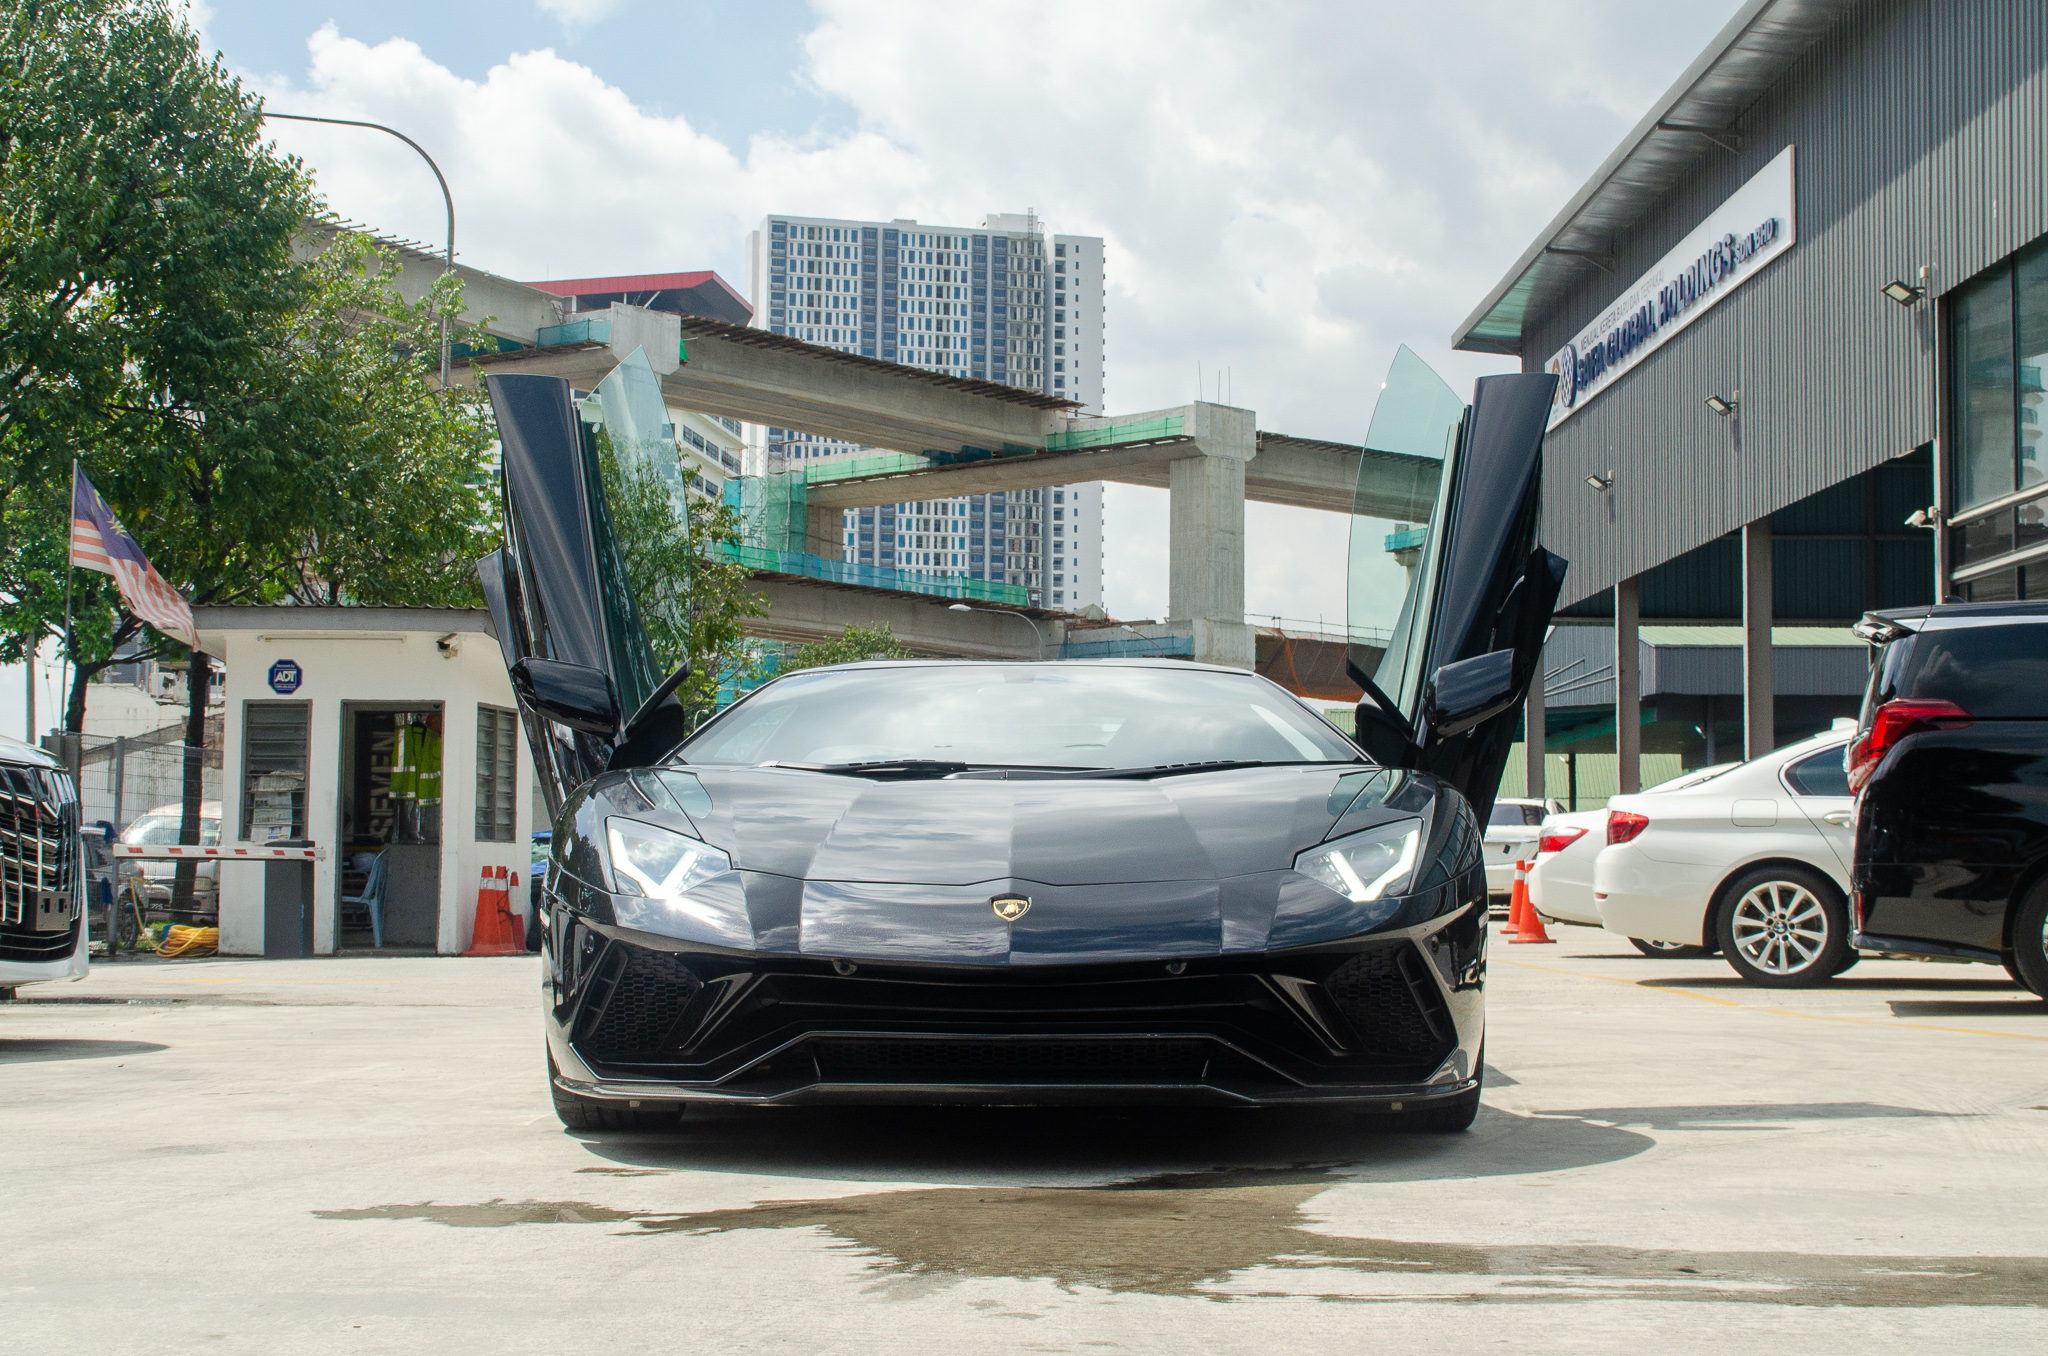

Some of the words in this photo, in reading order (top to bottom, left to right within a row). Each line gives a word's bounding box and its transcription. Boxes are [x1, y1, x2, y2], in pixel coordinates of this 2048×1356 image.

[1605, 300, 1656, 367] GLOBAL
[1658, 233, 1733, 327] HOLDINGS
[1734, 233, 1755, 264] SDN
[1755, 218, 1776, 250] BHD
[275, 670, 297, 682] ADT
